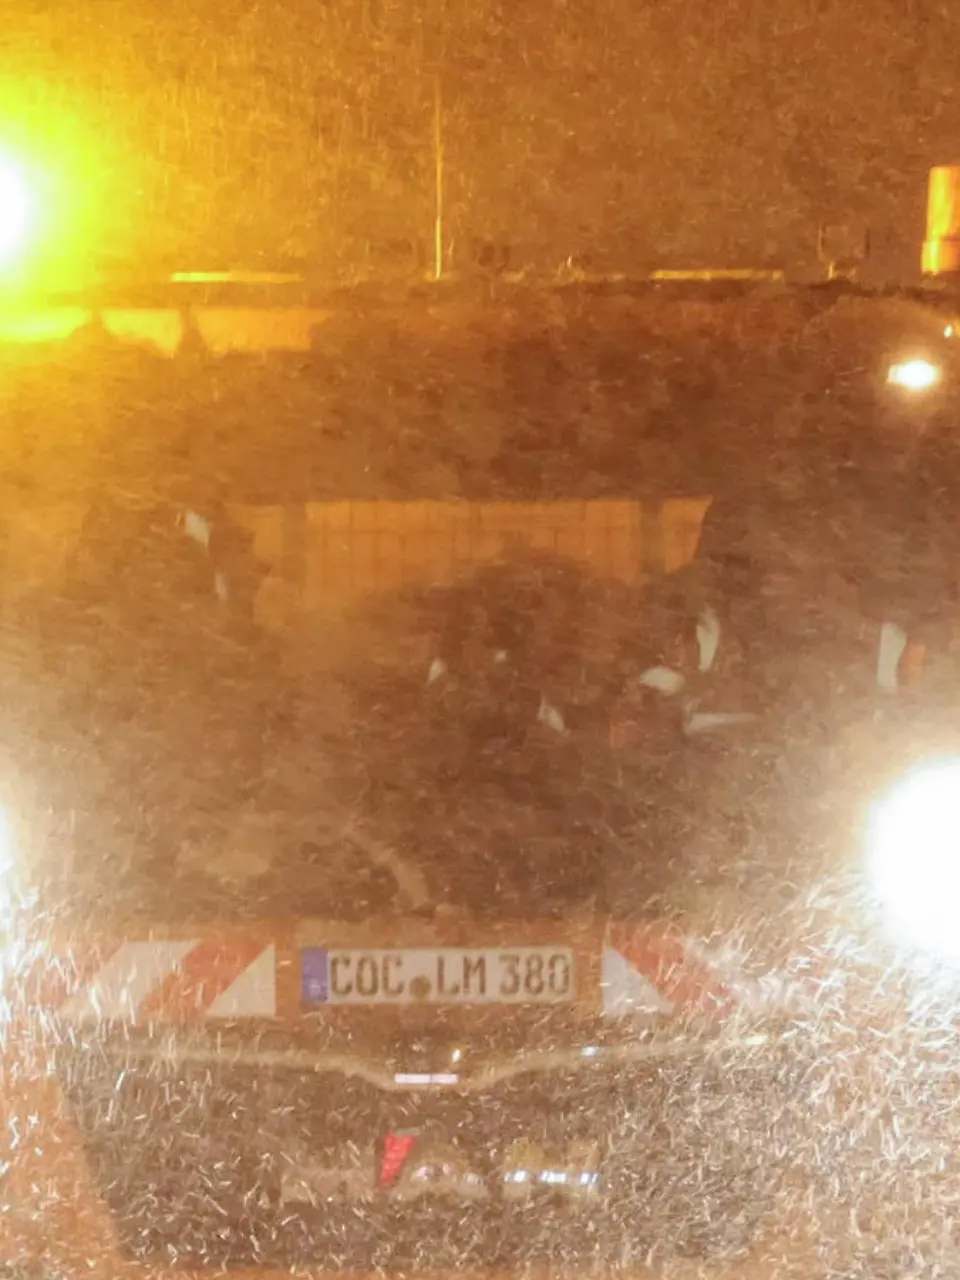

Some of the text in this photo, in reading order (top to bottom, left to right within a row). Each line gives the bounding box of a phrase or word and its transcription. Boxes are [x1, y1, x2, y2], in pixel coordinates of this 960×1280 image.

[330, 954, 404, 996] COC
[436, 954, 486, 996] LM
[498, 953, 571, 996] 380
